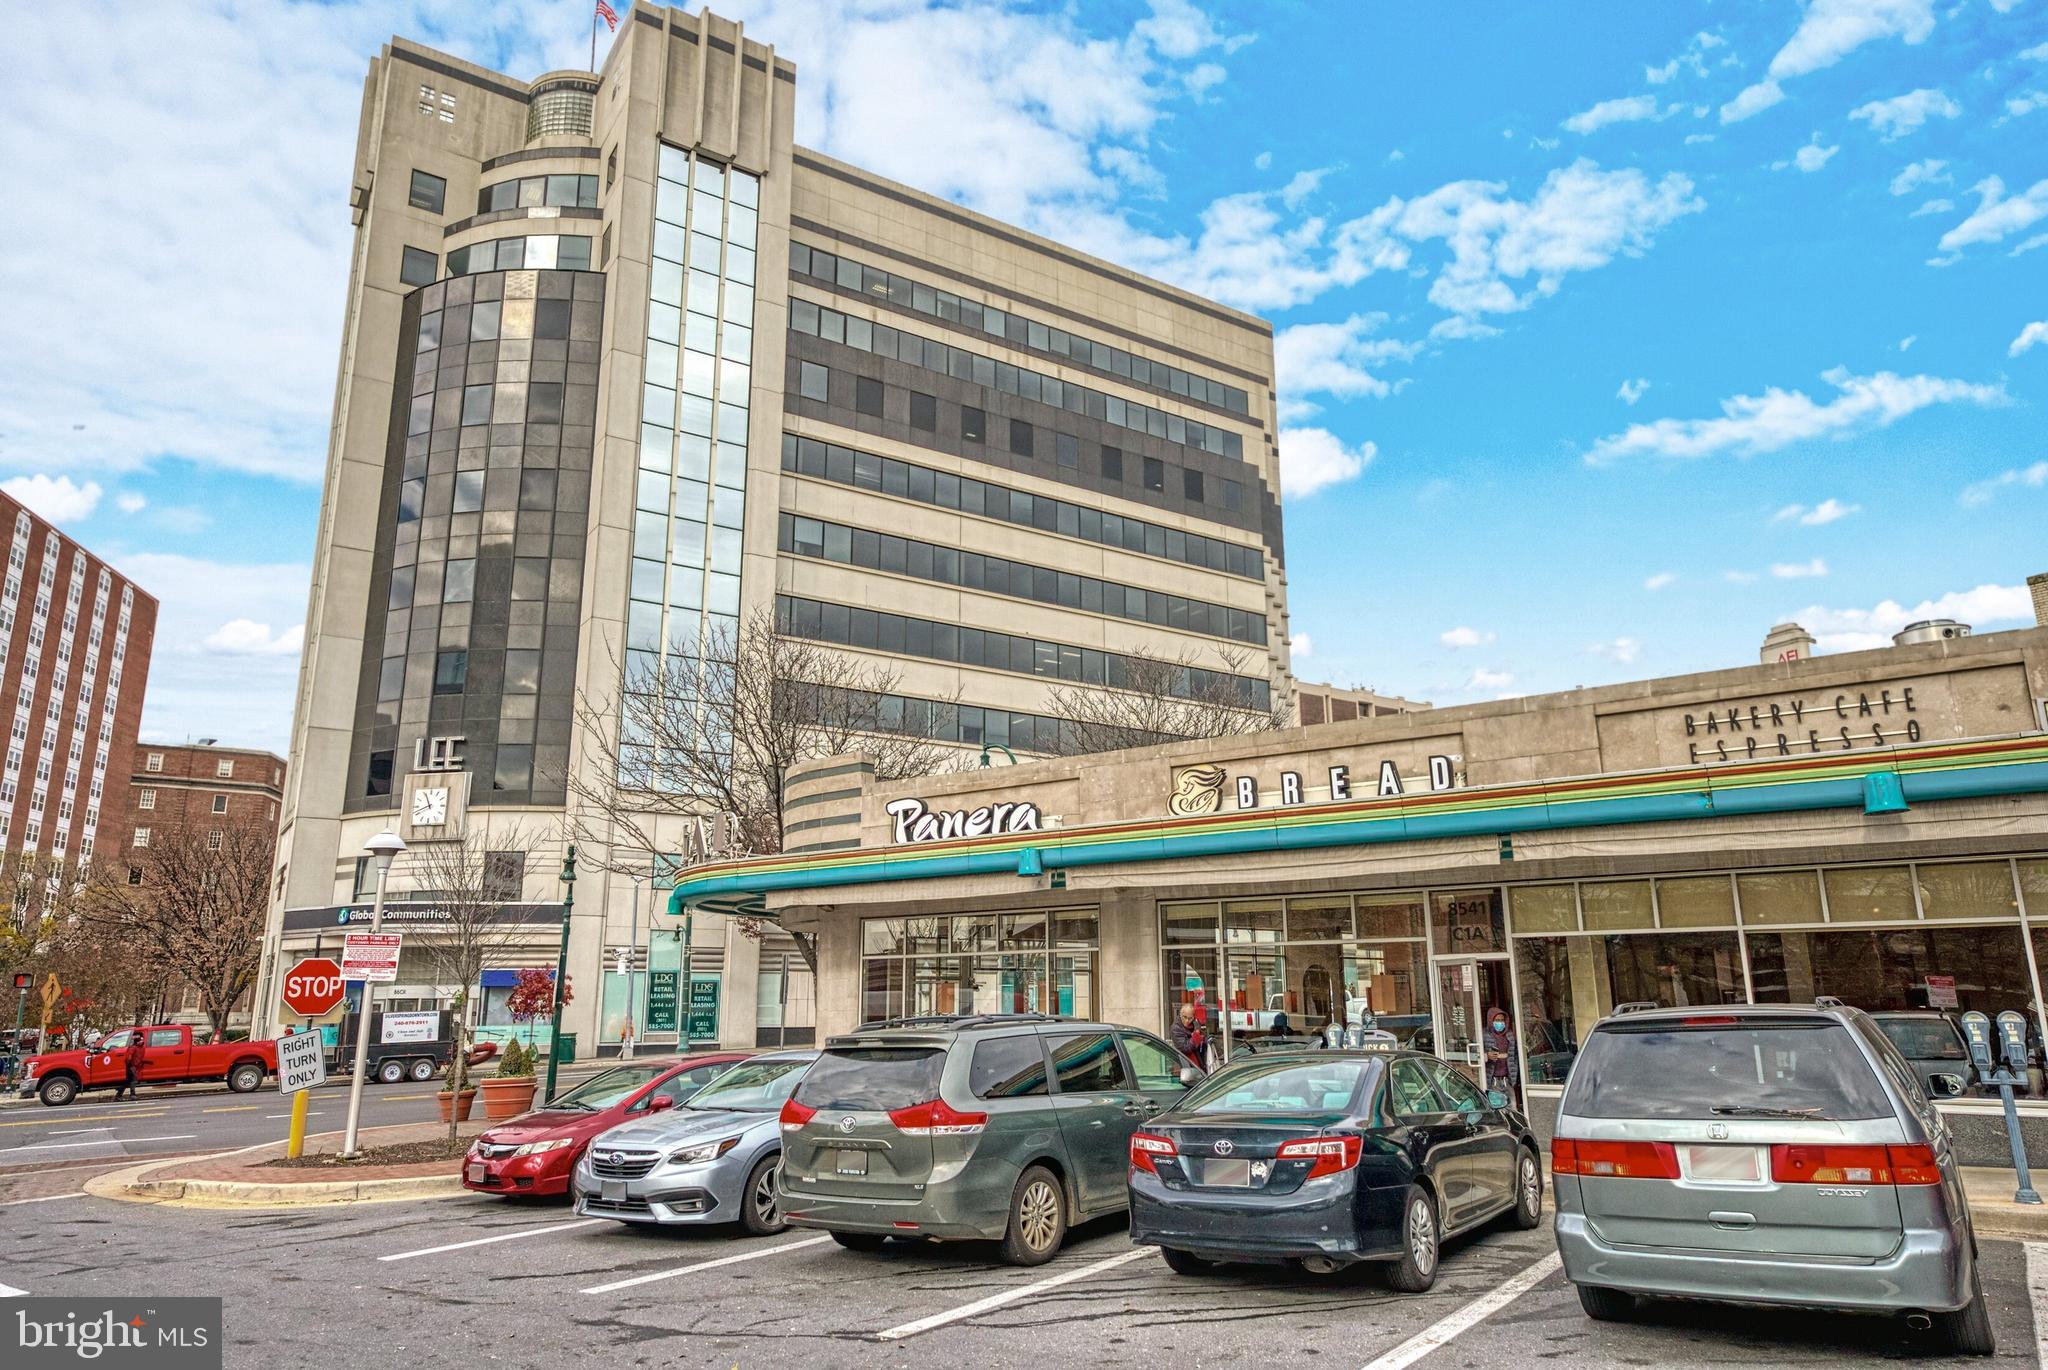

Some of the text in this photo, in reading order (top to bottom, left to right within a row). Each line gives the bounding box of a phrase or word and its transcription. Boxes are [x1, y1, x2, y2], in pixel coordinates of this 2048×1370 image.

[1685, 687, 1916, 736] BAKERY CAFE
[1689, 719, 1920, 764] ESPRESSO
[414, 735, 465, 770] LEE
[1237, 755, 1453, 809] BREAD
[886, 797, 1043, 844] Panera
[350, 909, 451, 920] Globa Communities
[1448, 901, 1486, 915] 8541
[1453, 927, 1485, 941] C1A
[655, 973, 673, 982] LDG
[287, 976, 342, 998] STOP
[283, 1036, 316, 1054] RIGHT
[286, 1052, 317, 1070] TURN
[288, 1068, 317, 1086] ONLY
[1817, 1188, 1869, 1198] ODYSSEY
